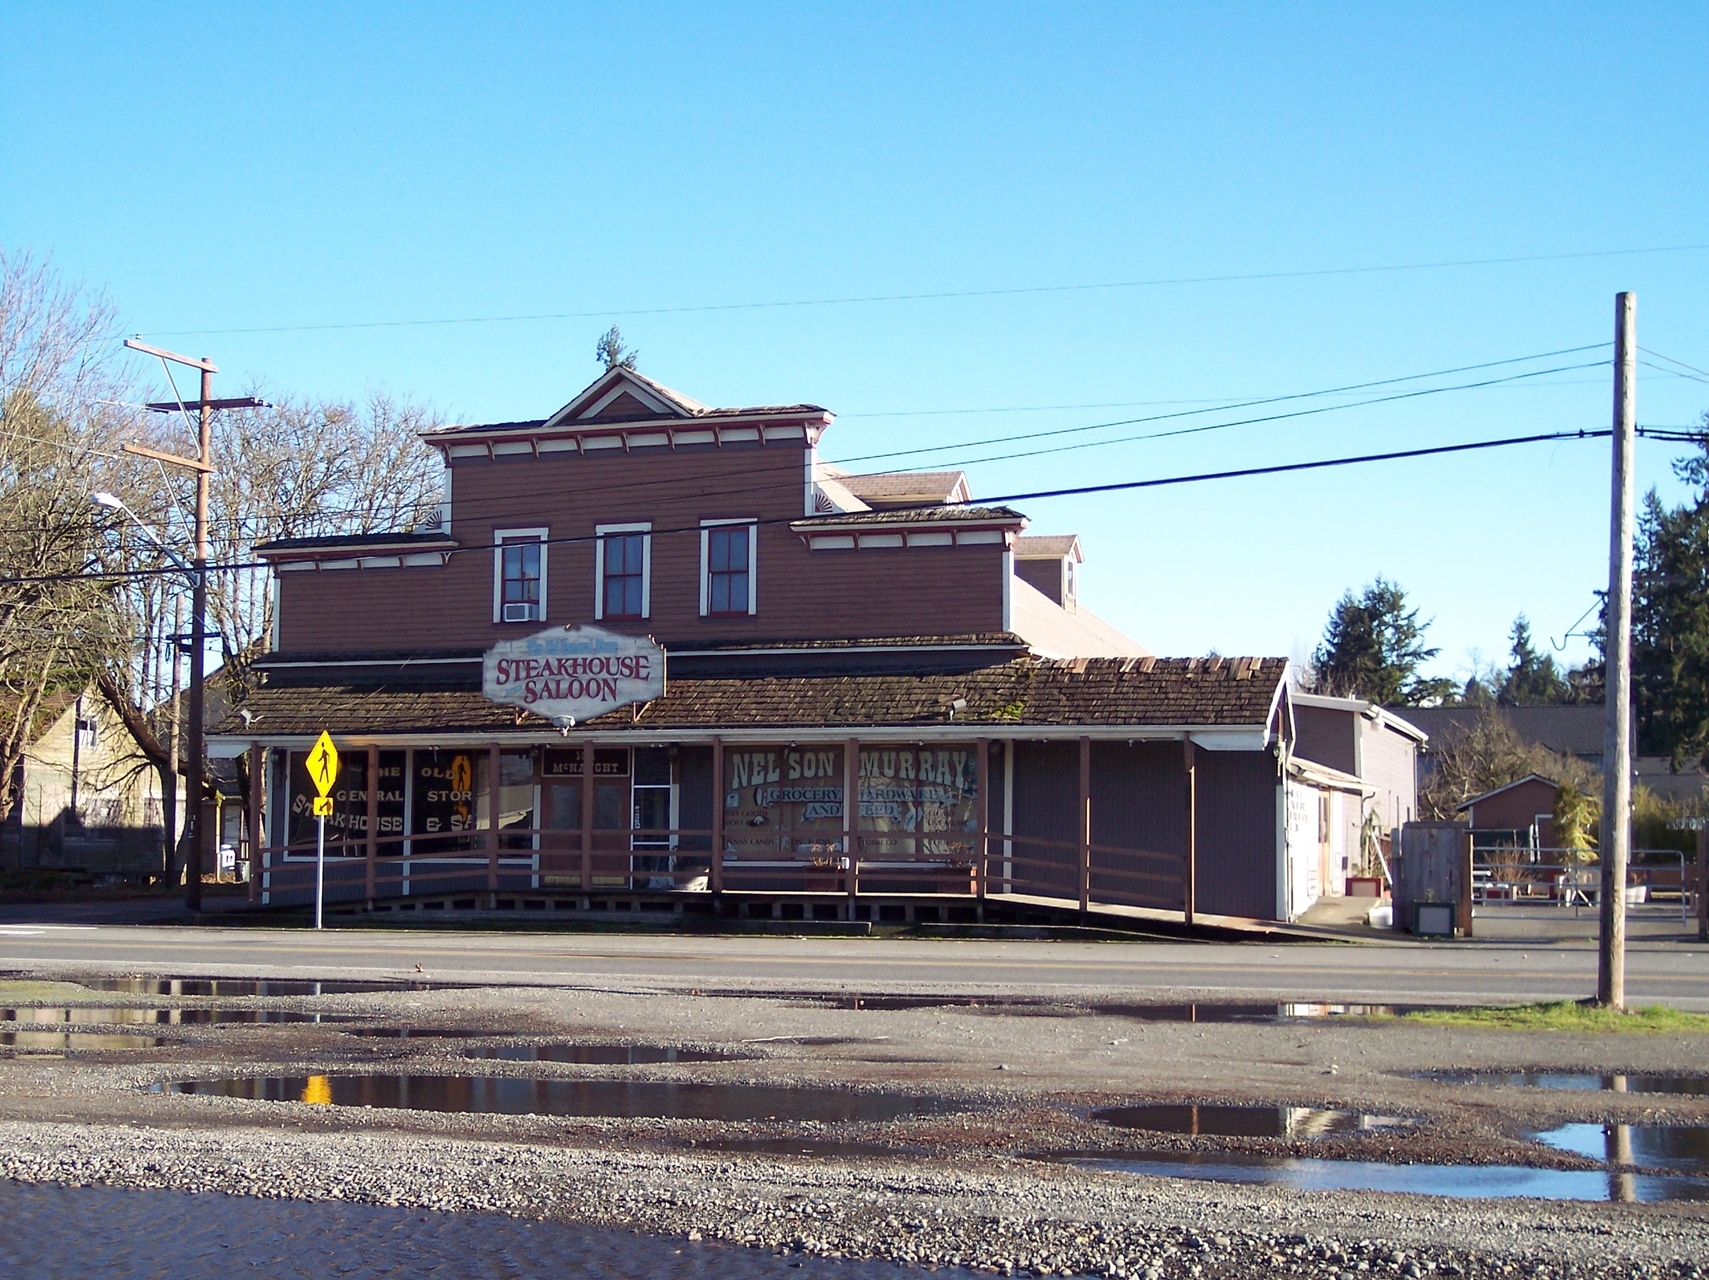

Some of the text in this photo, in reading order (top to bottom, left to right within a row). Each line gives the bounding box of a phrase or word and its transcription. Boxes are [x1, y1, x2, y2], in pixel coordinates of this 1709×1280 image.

[496, 655, 651, 686] STEAKHOUSE
[523, 677, 619, 704] SALOON
[376, 767, 455, 780] HE OLD
[553, 763, 618, 773] McNAGHT
[336, 790, 472, 802] GENRAL STOR
[292, 794, 403, 832] STAKHOSE
[427, 817, 442, 832] &
[808, 804, 840, 816] AND
